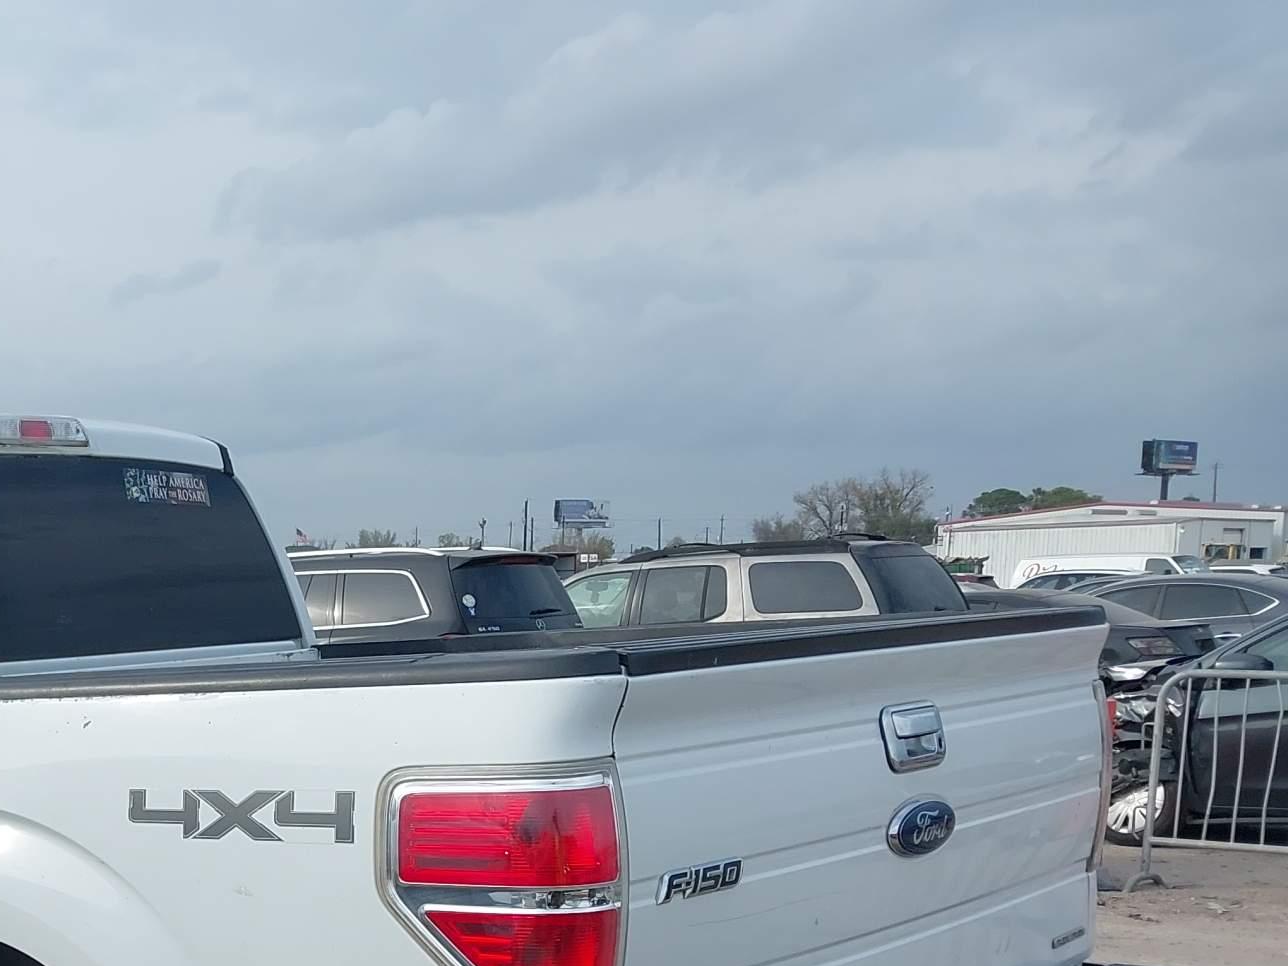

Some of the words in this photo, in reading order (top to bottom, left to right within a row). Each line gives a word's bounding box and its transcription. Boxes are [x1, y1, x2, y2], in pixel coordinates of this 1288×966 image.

[146, 474, 167, 487] HELP
[169, 477, 205, 490] AMERICA
[148, 486, 168, 500] PRAY
[177, 488, 206, 502] ROSARY
[913, 809, 949, 845] Ford
